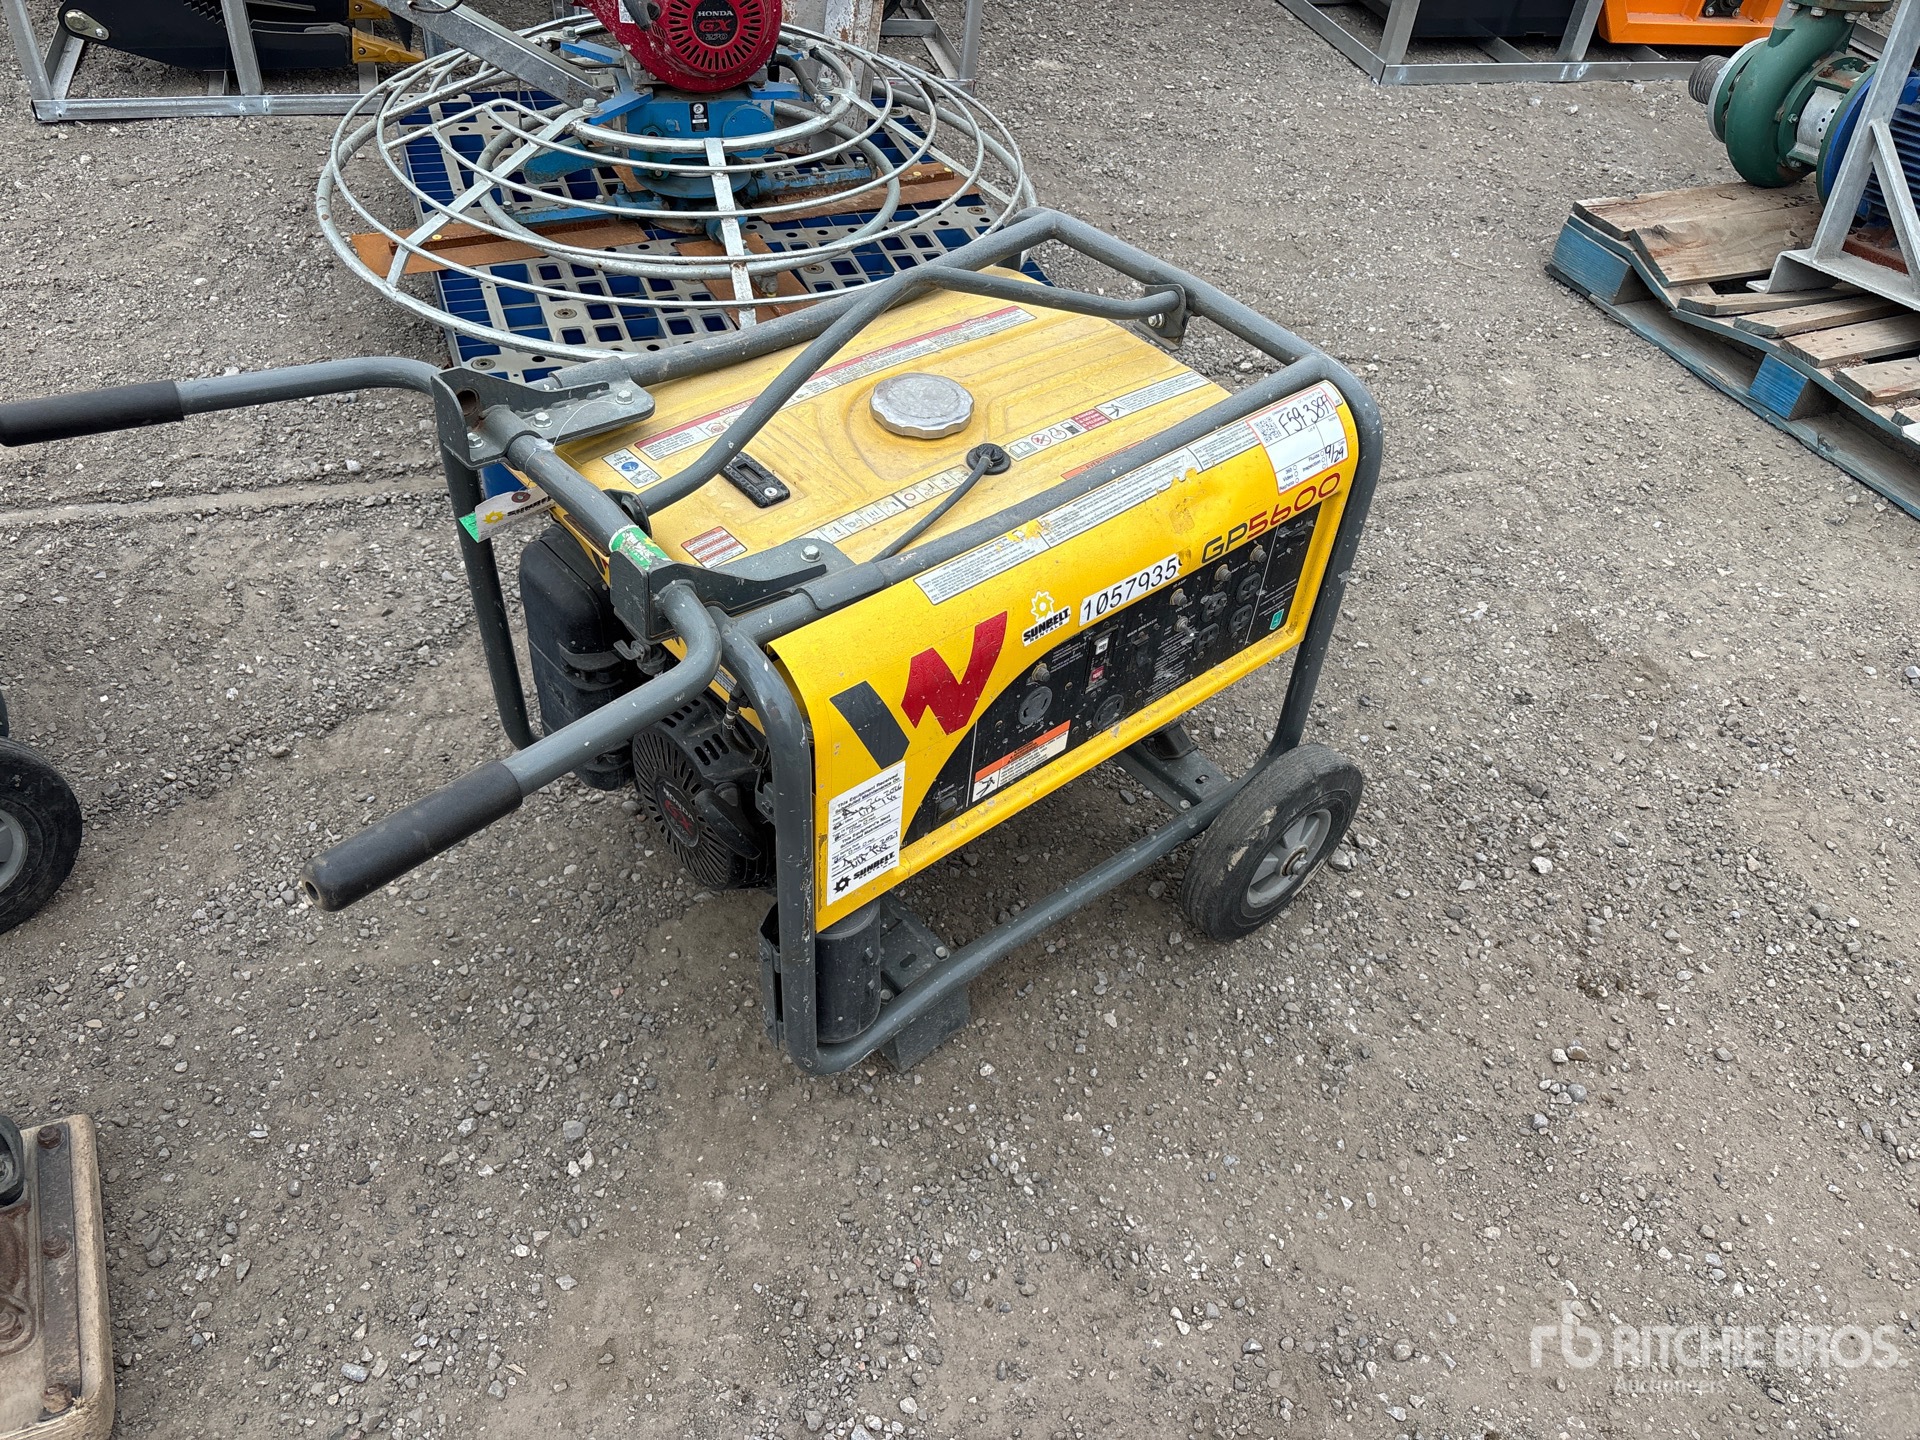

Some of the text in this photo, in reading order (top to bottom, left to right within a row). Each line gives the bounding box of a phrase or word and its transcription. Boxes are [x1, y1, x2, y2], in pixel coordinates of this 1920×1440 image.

[699, 19, 733, 32] GX
[1324, 444, 1344, 464] 9/29
[1283, 474, 1294, 482] Video
[1201, 472, 1341, 564] GP5600
[1083, 555, 1181, 621] 1057935
[1022, 607, 1070, 642] SUNBELT
[1030, 621, 1064, 643] RENTALS
[662, 786, 695, 823] HONDA
[837, 772, 898, 808] This Equipment Received
[862, 780, 891, 799] Maintenance
[840, 832, 863, 849] Scheduled
[864, 817, 891, 835] Maintenance
[853, 850, 895, 880] SUNBELT
